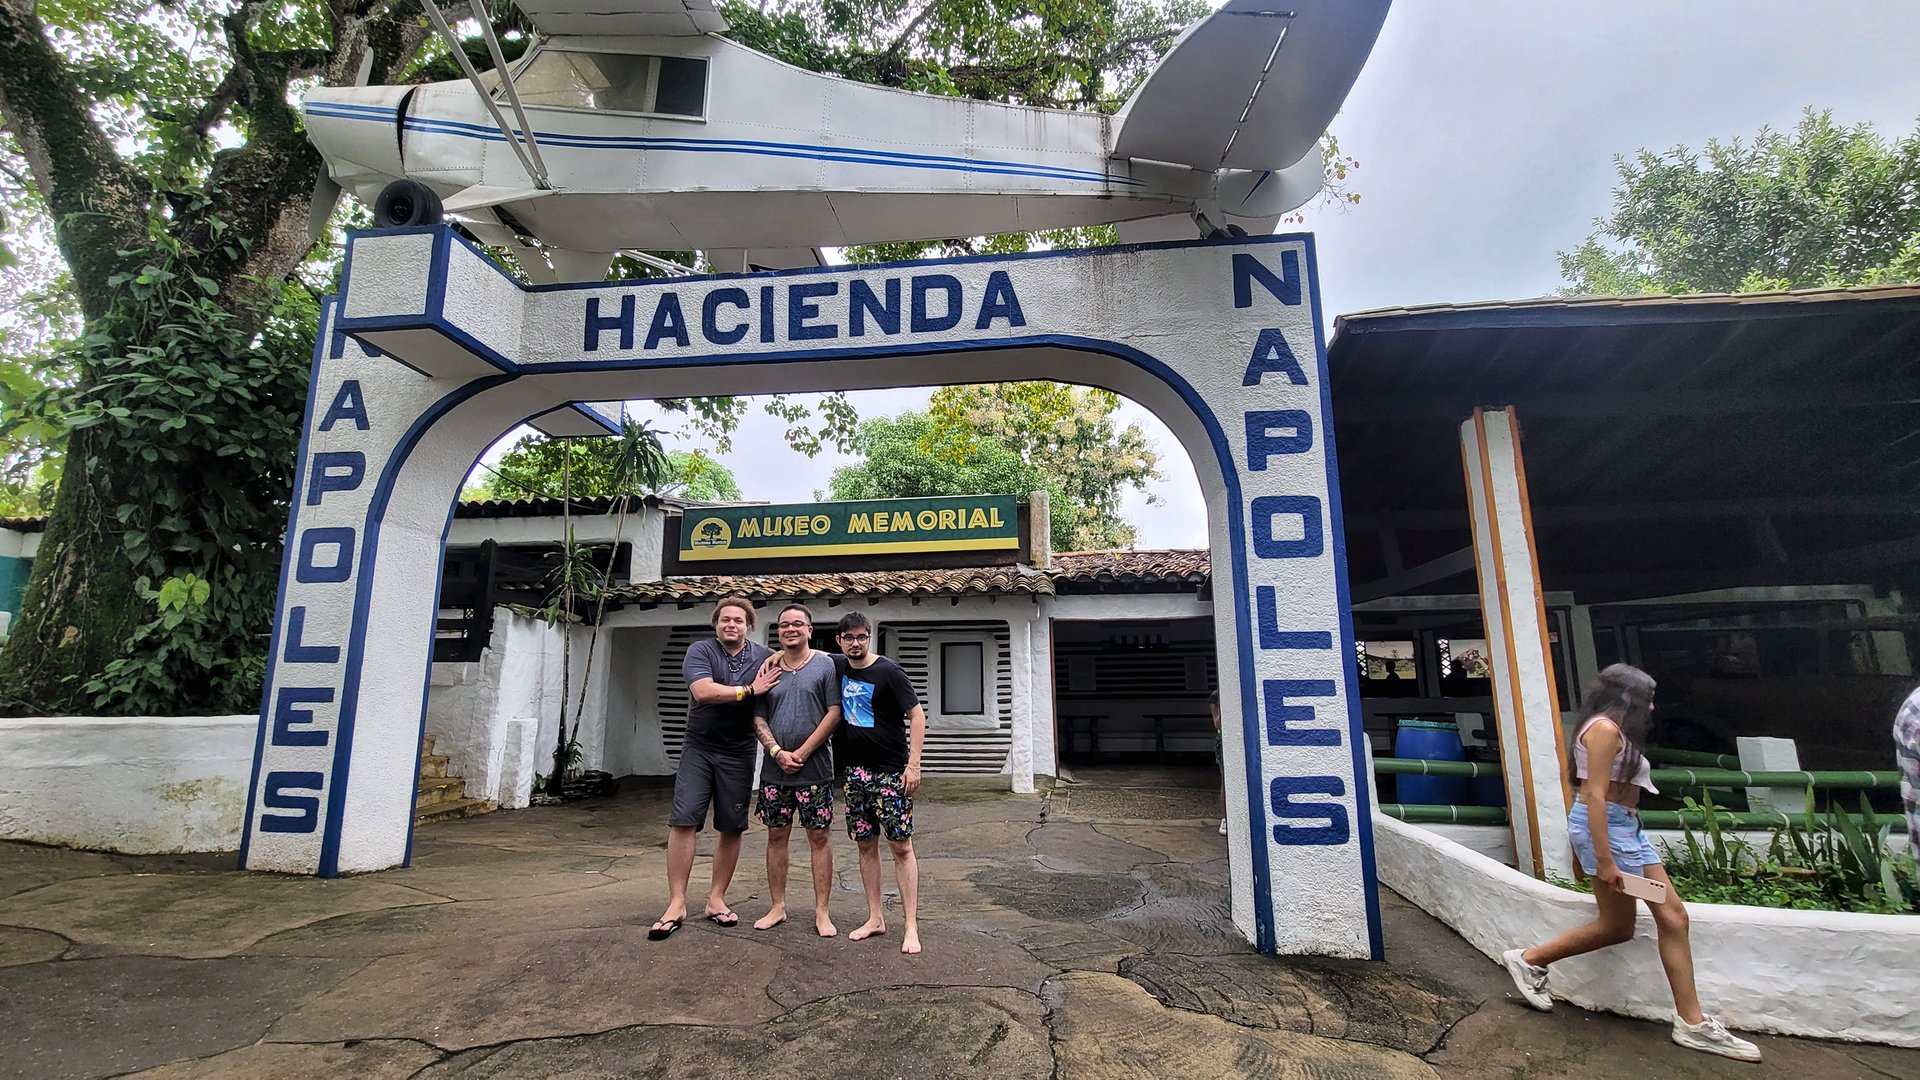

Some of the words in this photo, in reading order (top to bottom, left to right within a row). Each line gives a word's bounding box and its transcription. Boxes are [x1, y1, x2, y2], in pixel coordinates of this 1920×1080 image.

[584, 270, 1026, 351] HACIENDA
[737, 513, 831, 538] MUSEO
[847, 507, 1004, 534] MEMORIAL
[1232, 250, 1350, 846] NAPOLES
